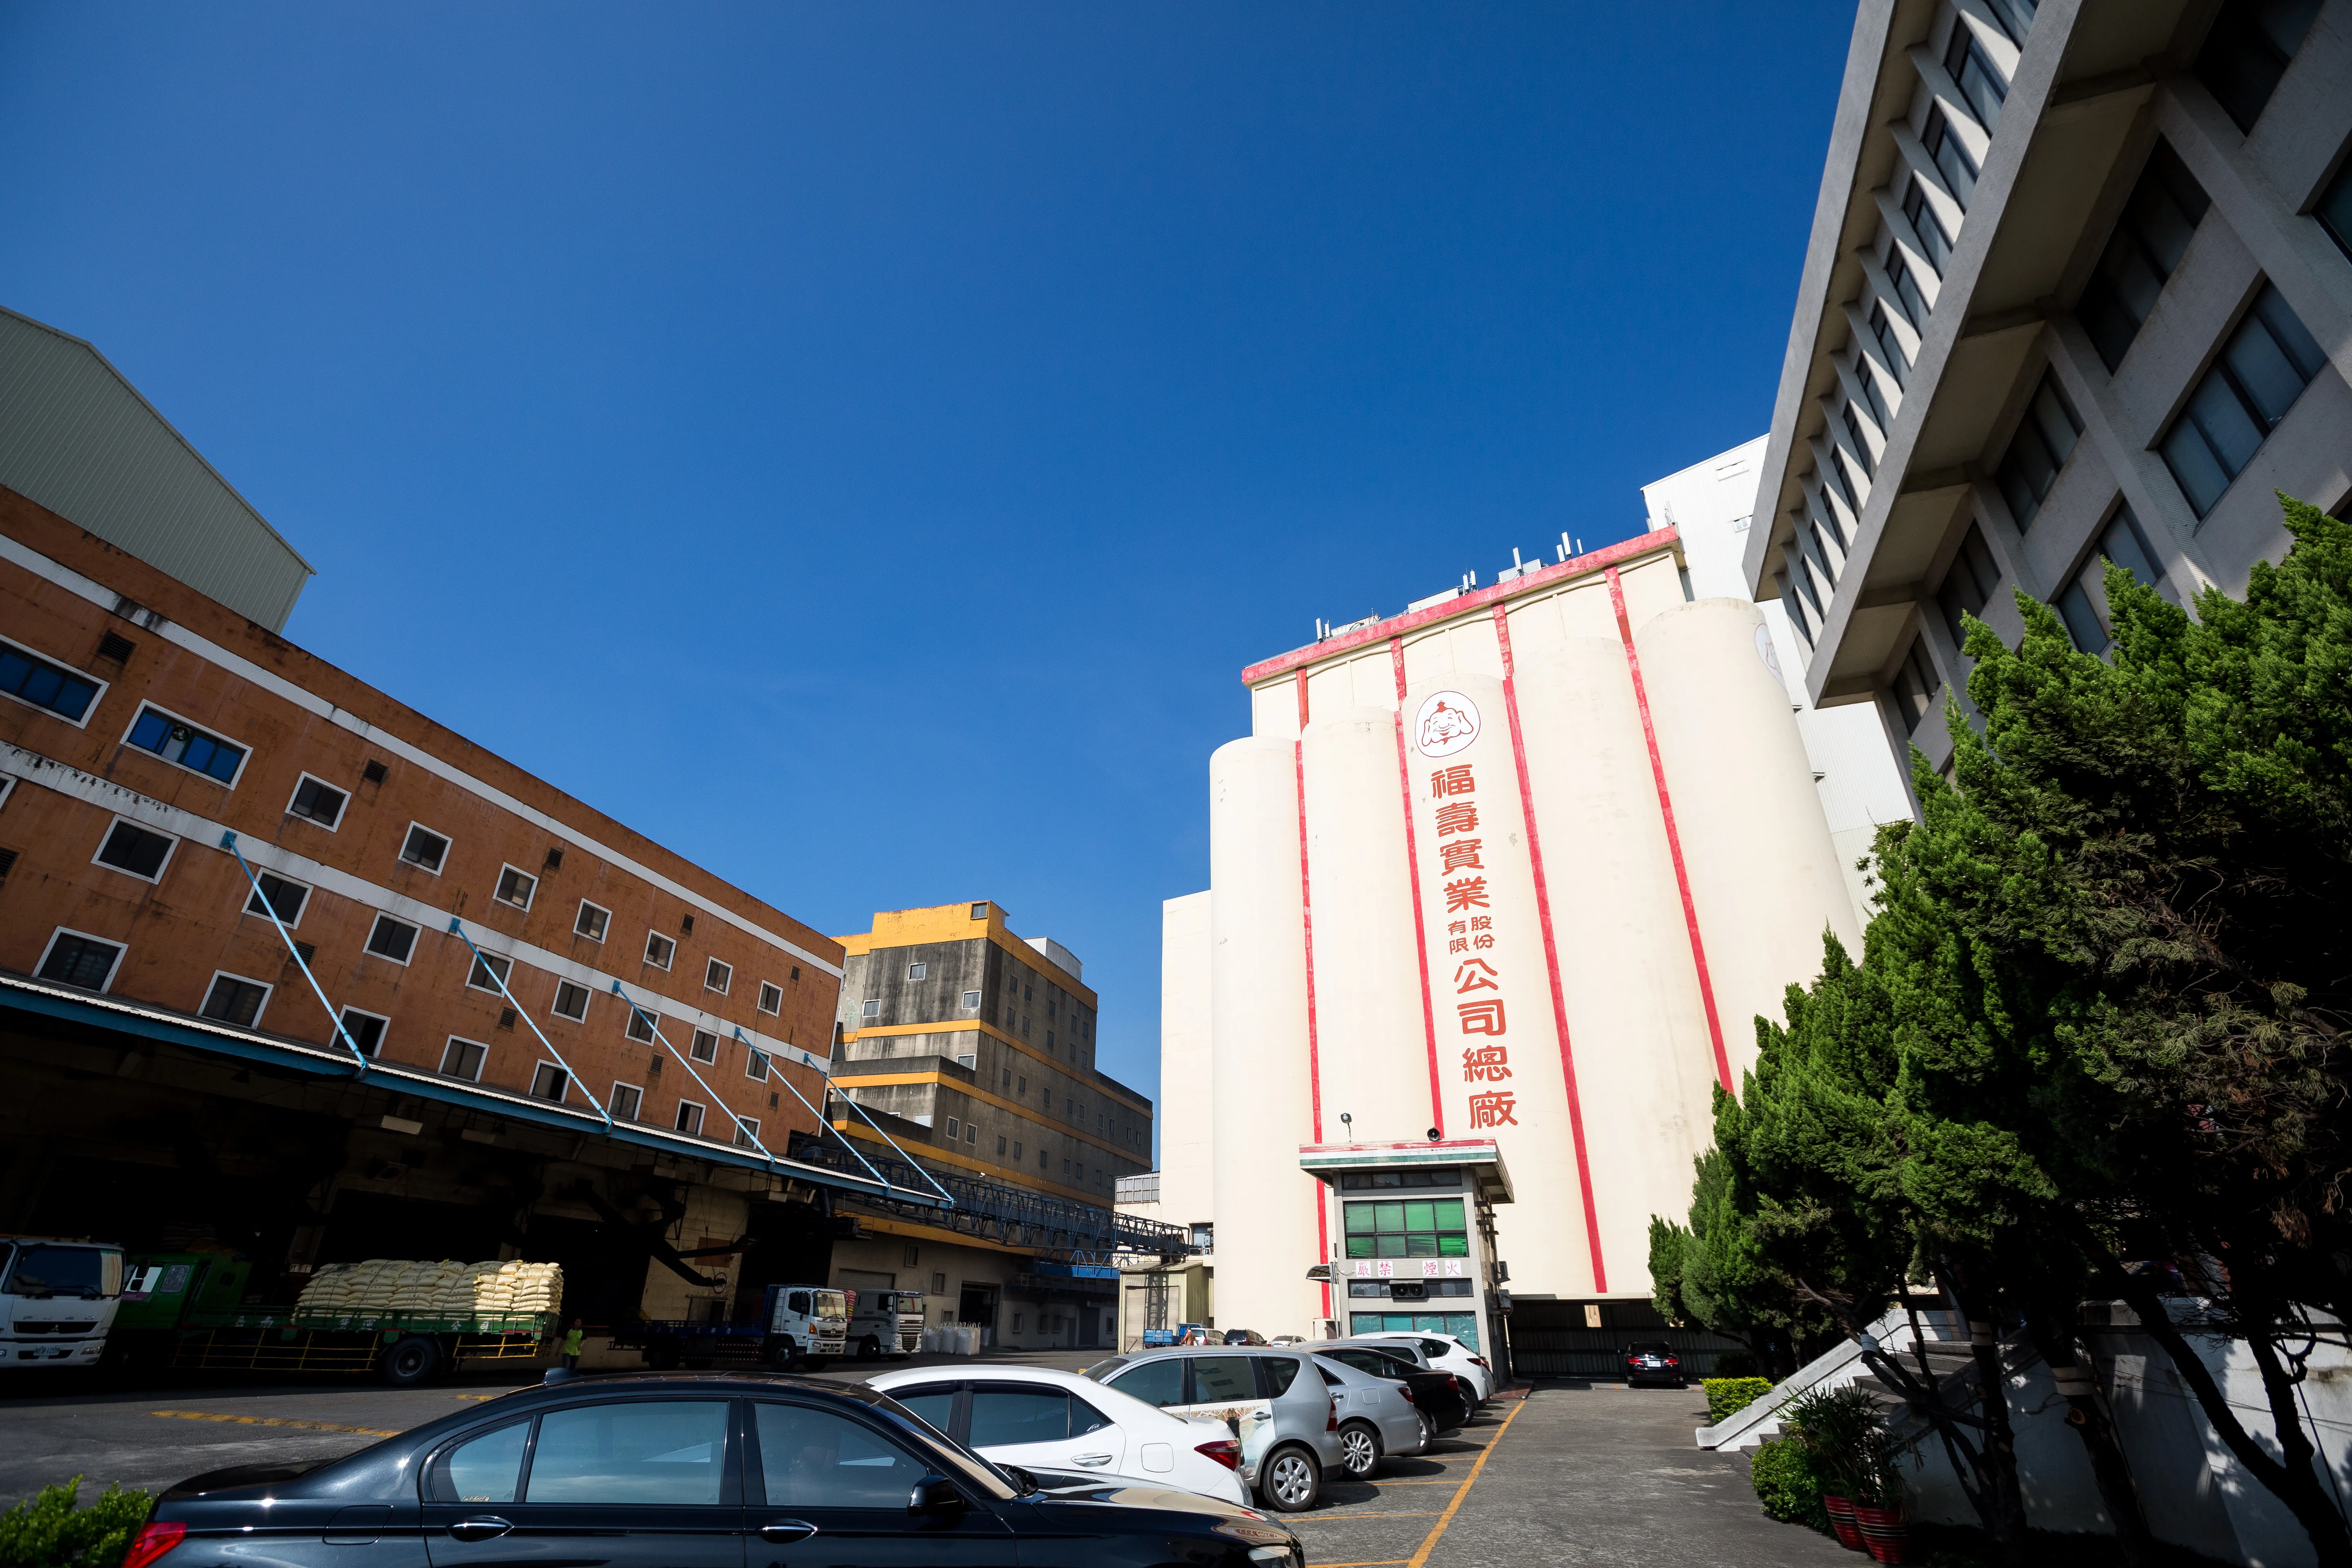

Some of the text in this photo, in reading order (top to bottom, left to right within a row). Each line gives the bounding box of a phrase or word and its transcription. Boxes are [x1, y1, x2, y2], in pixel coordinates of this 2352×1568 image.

[1431, 764, 1490, 913] 福壽實業
[1454, 958, 1518, 1129] 公司總廠
